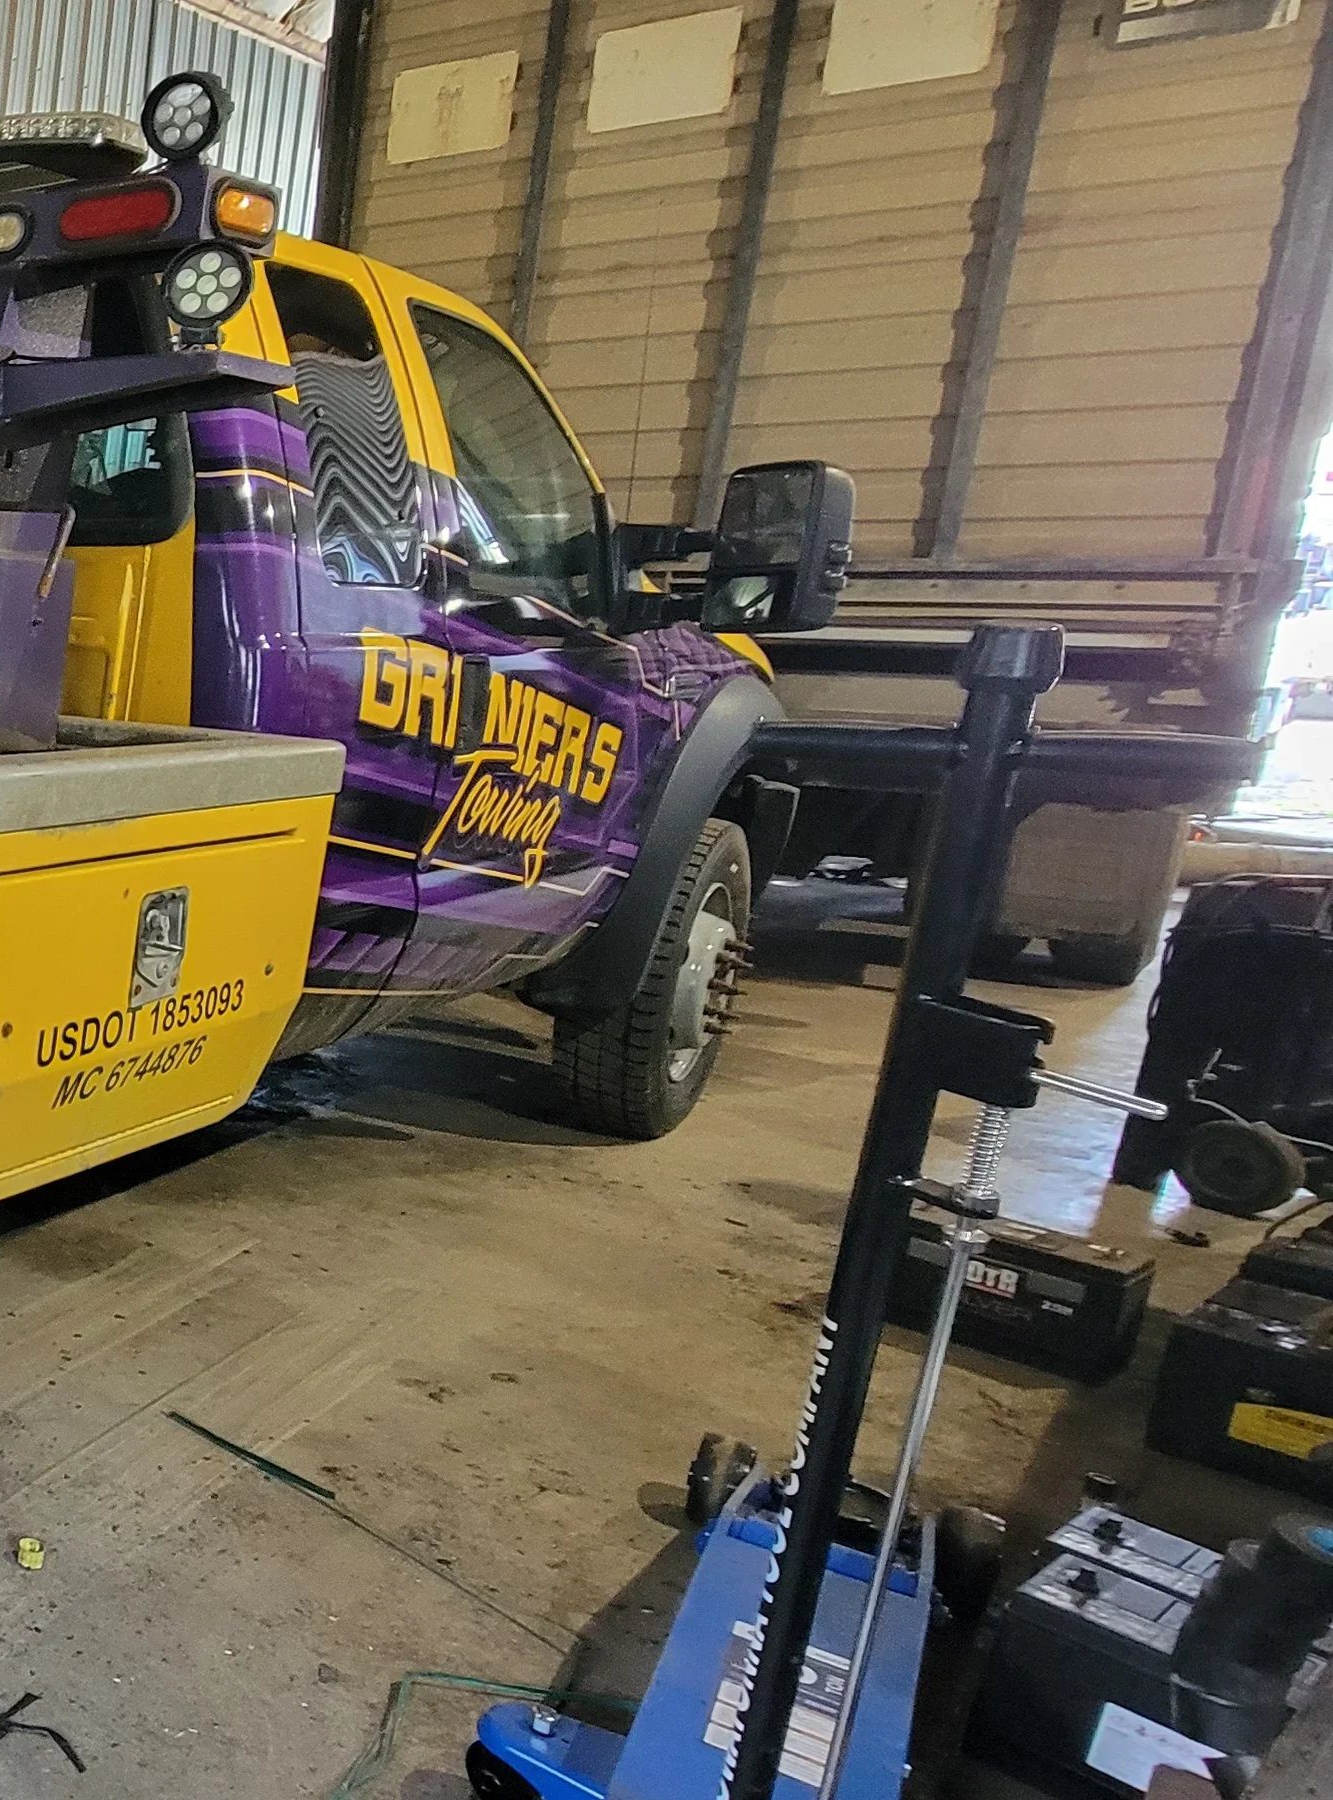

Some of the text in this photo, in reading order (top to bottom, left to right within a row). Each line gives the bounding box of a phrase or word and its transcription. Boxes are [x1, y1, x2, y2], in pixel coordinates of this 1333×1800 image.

[422, 749, 561, 889] Towing
[37, 978, 245, 1068] USDOT 1853093
[50, 1034, 208, 1110] MC 6744876
